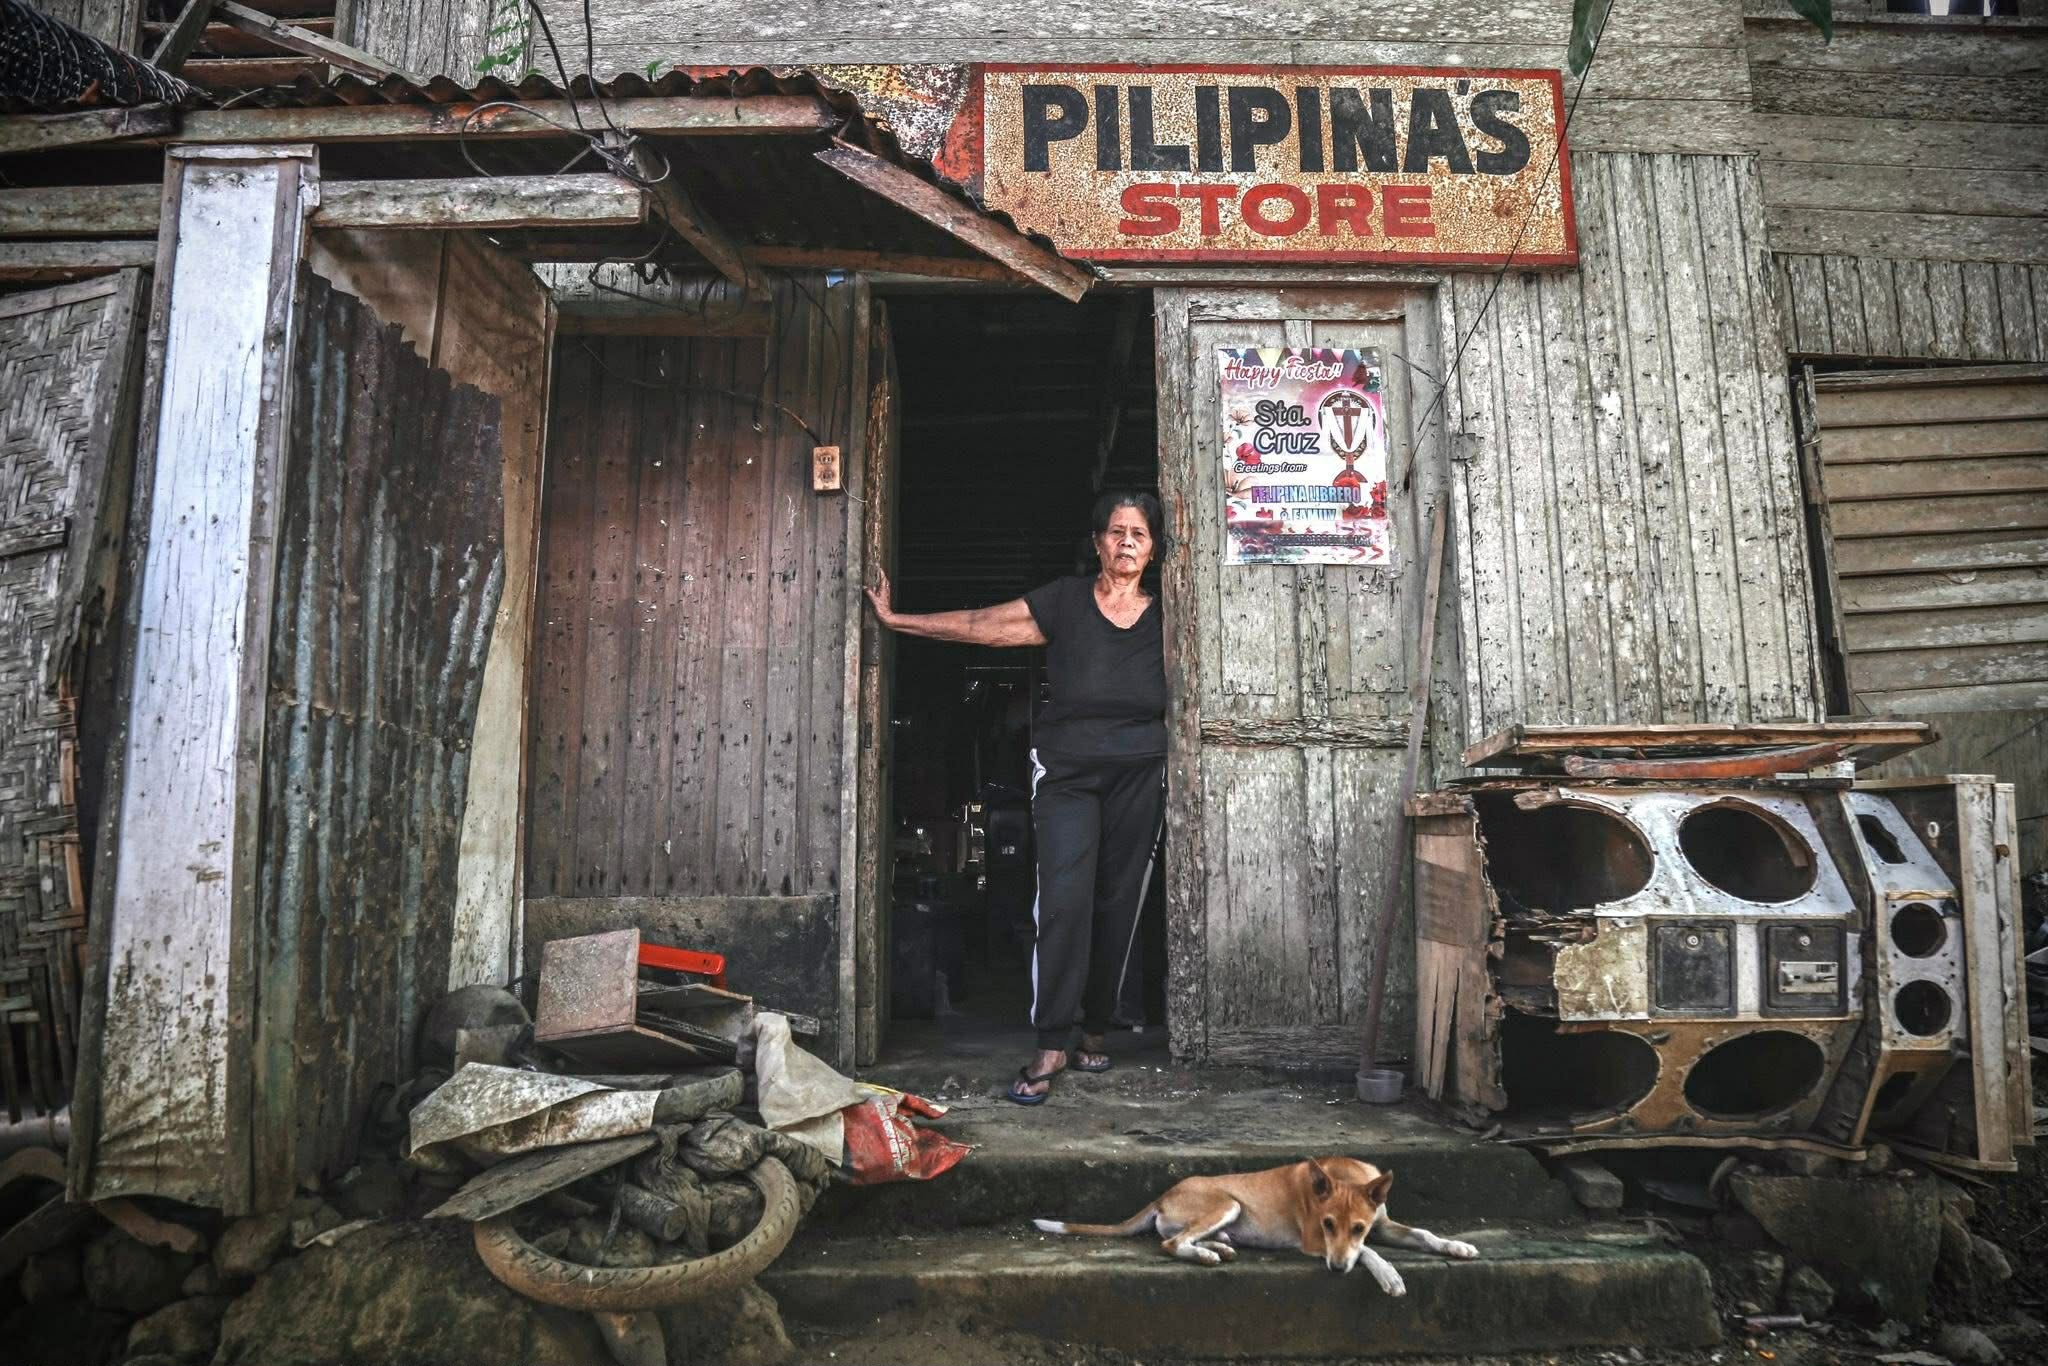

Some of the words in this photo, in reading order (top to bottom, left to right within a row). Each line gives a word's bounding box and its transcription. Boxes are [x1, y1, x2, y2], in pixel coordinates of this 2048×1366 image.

[1021, 79, 1531, 176] PILIPINA'S
[1119, 183, 1436, 238] STORE
[1224, 358, 1281, 388] Happy
[1286, 356, 1343, 381] Fiesta!!
[1254, 399, 1312, 427] Sta.
[1253, 427, 1320, 455] Cruz
[1234, 462, 1280, 474] Greetings
[1280, 461, 1308, 473] from:
[1252, 485, 1307, 503] FELIPINA
[1308, 485, 1361, 503] LIBRERO
